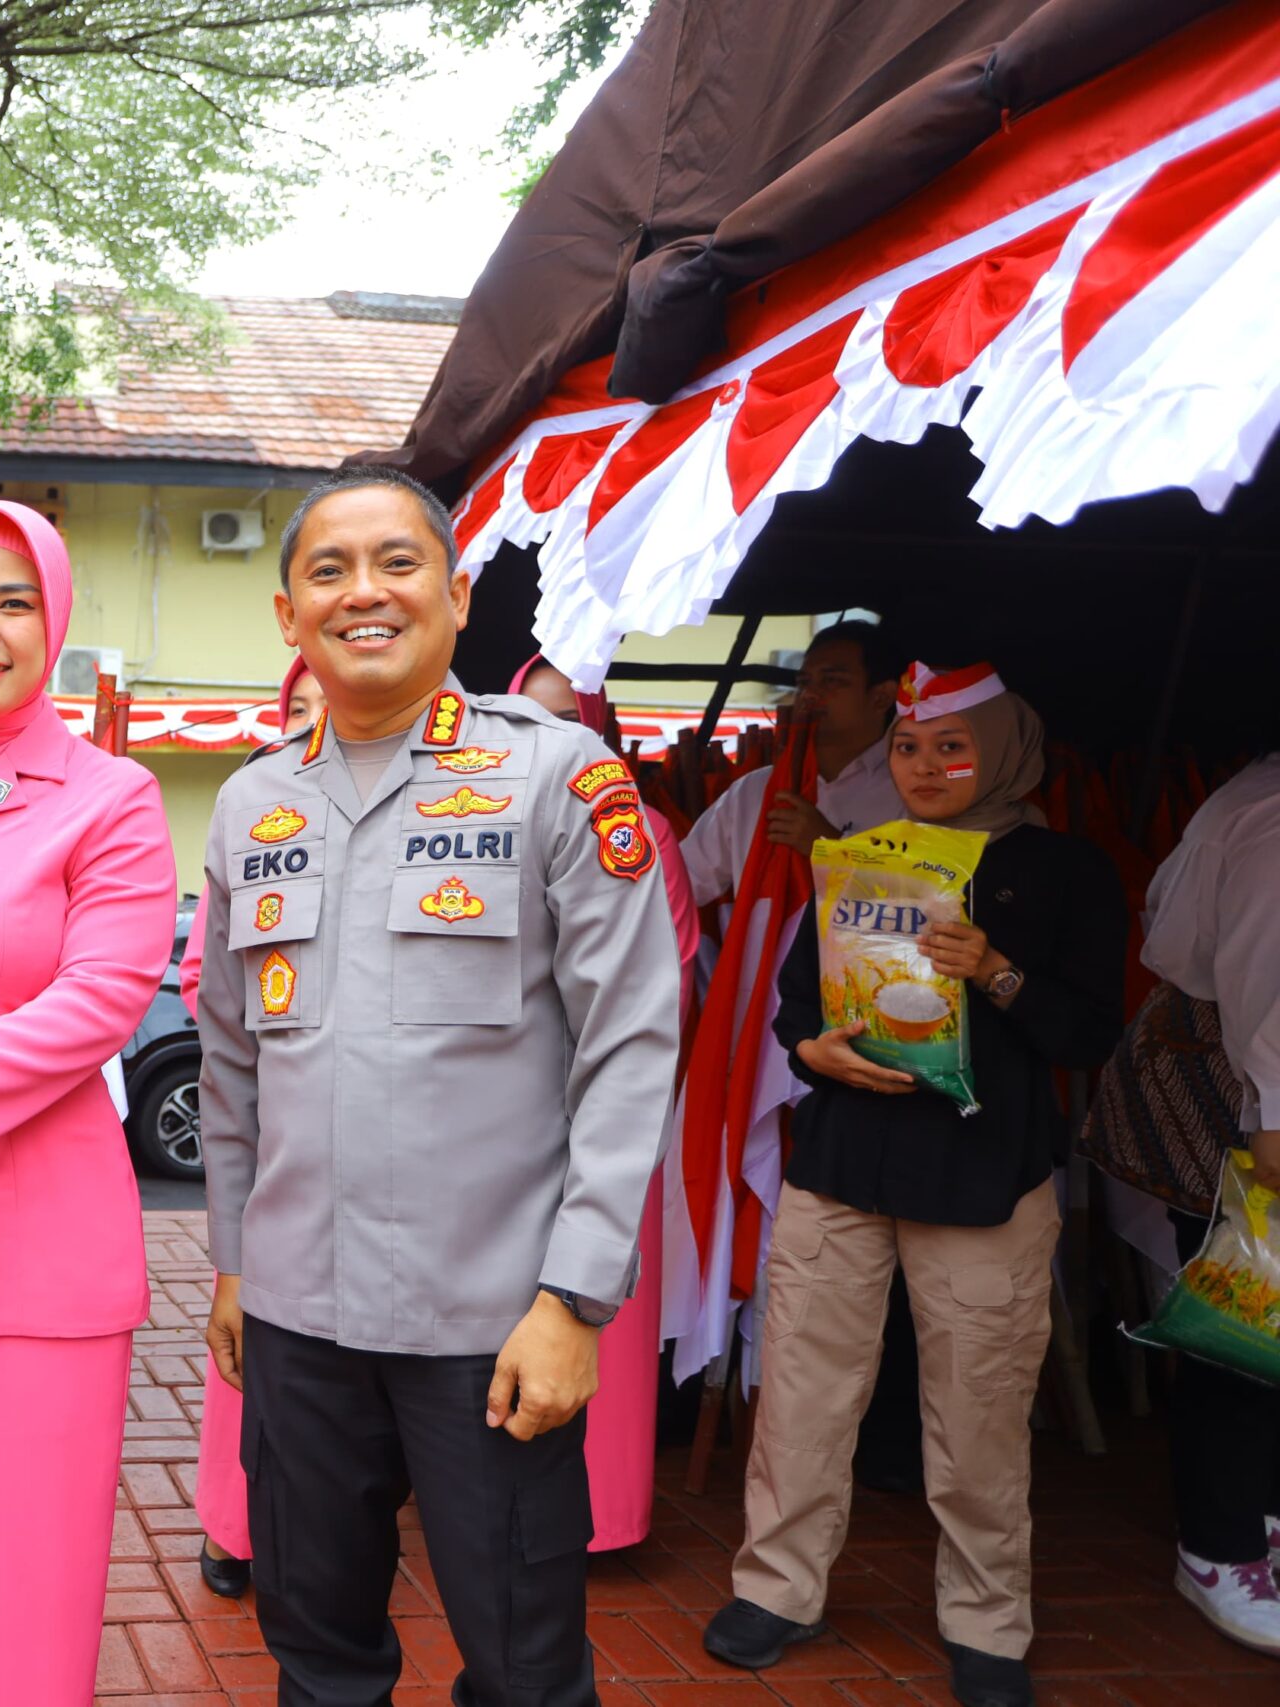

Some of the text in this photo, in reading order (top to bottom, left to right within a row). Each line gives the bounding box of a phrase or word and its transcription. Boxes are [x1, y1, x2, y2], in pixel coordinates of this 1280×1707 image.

[610, 792, 634, 802] BARAT
[406, 831, 513, 862] POLRI
[243, 847, 308, 881] EKO
[922, 860, 957, 881] bulog
[832, 897, 928, 935] SPHP
